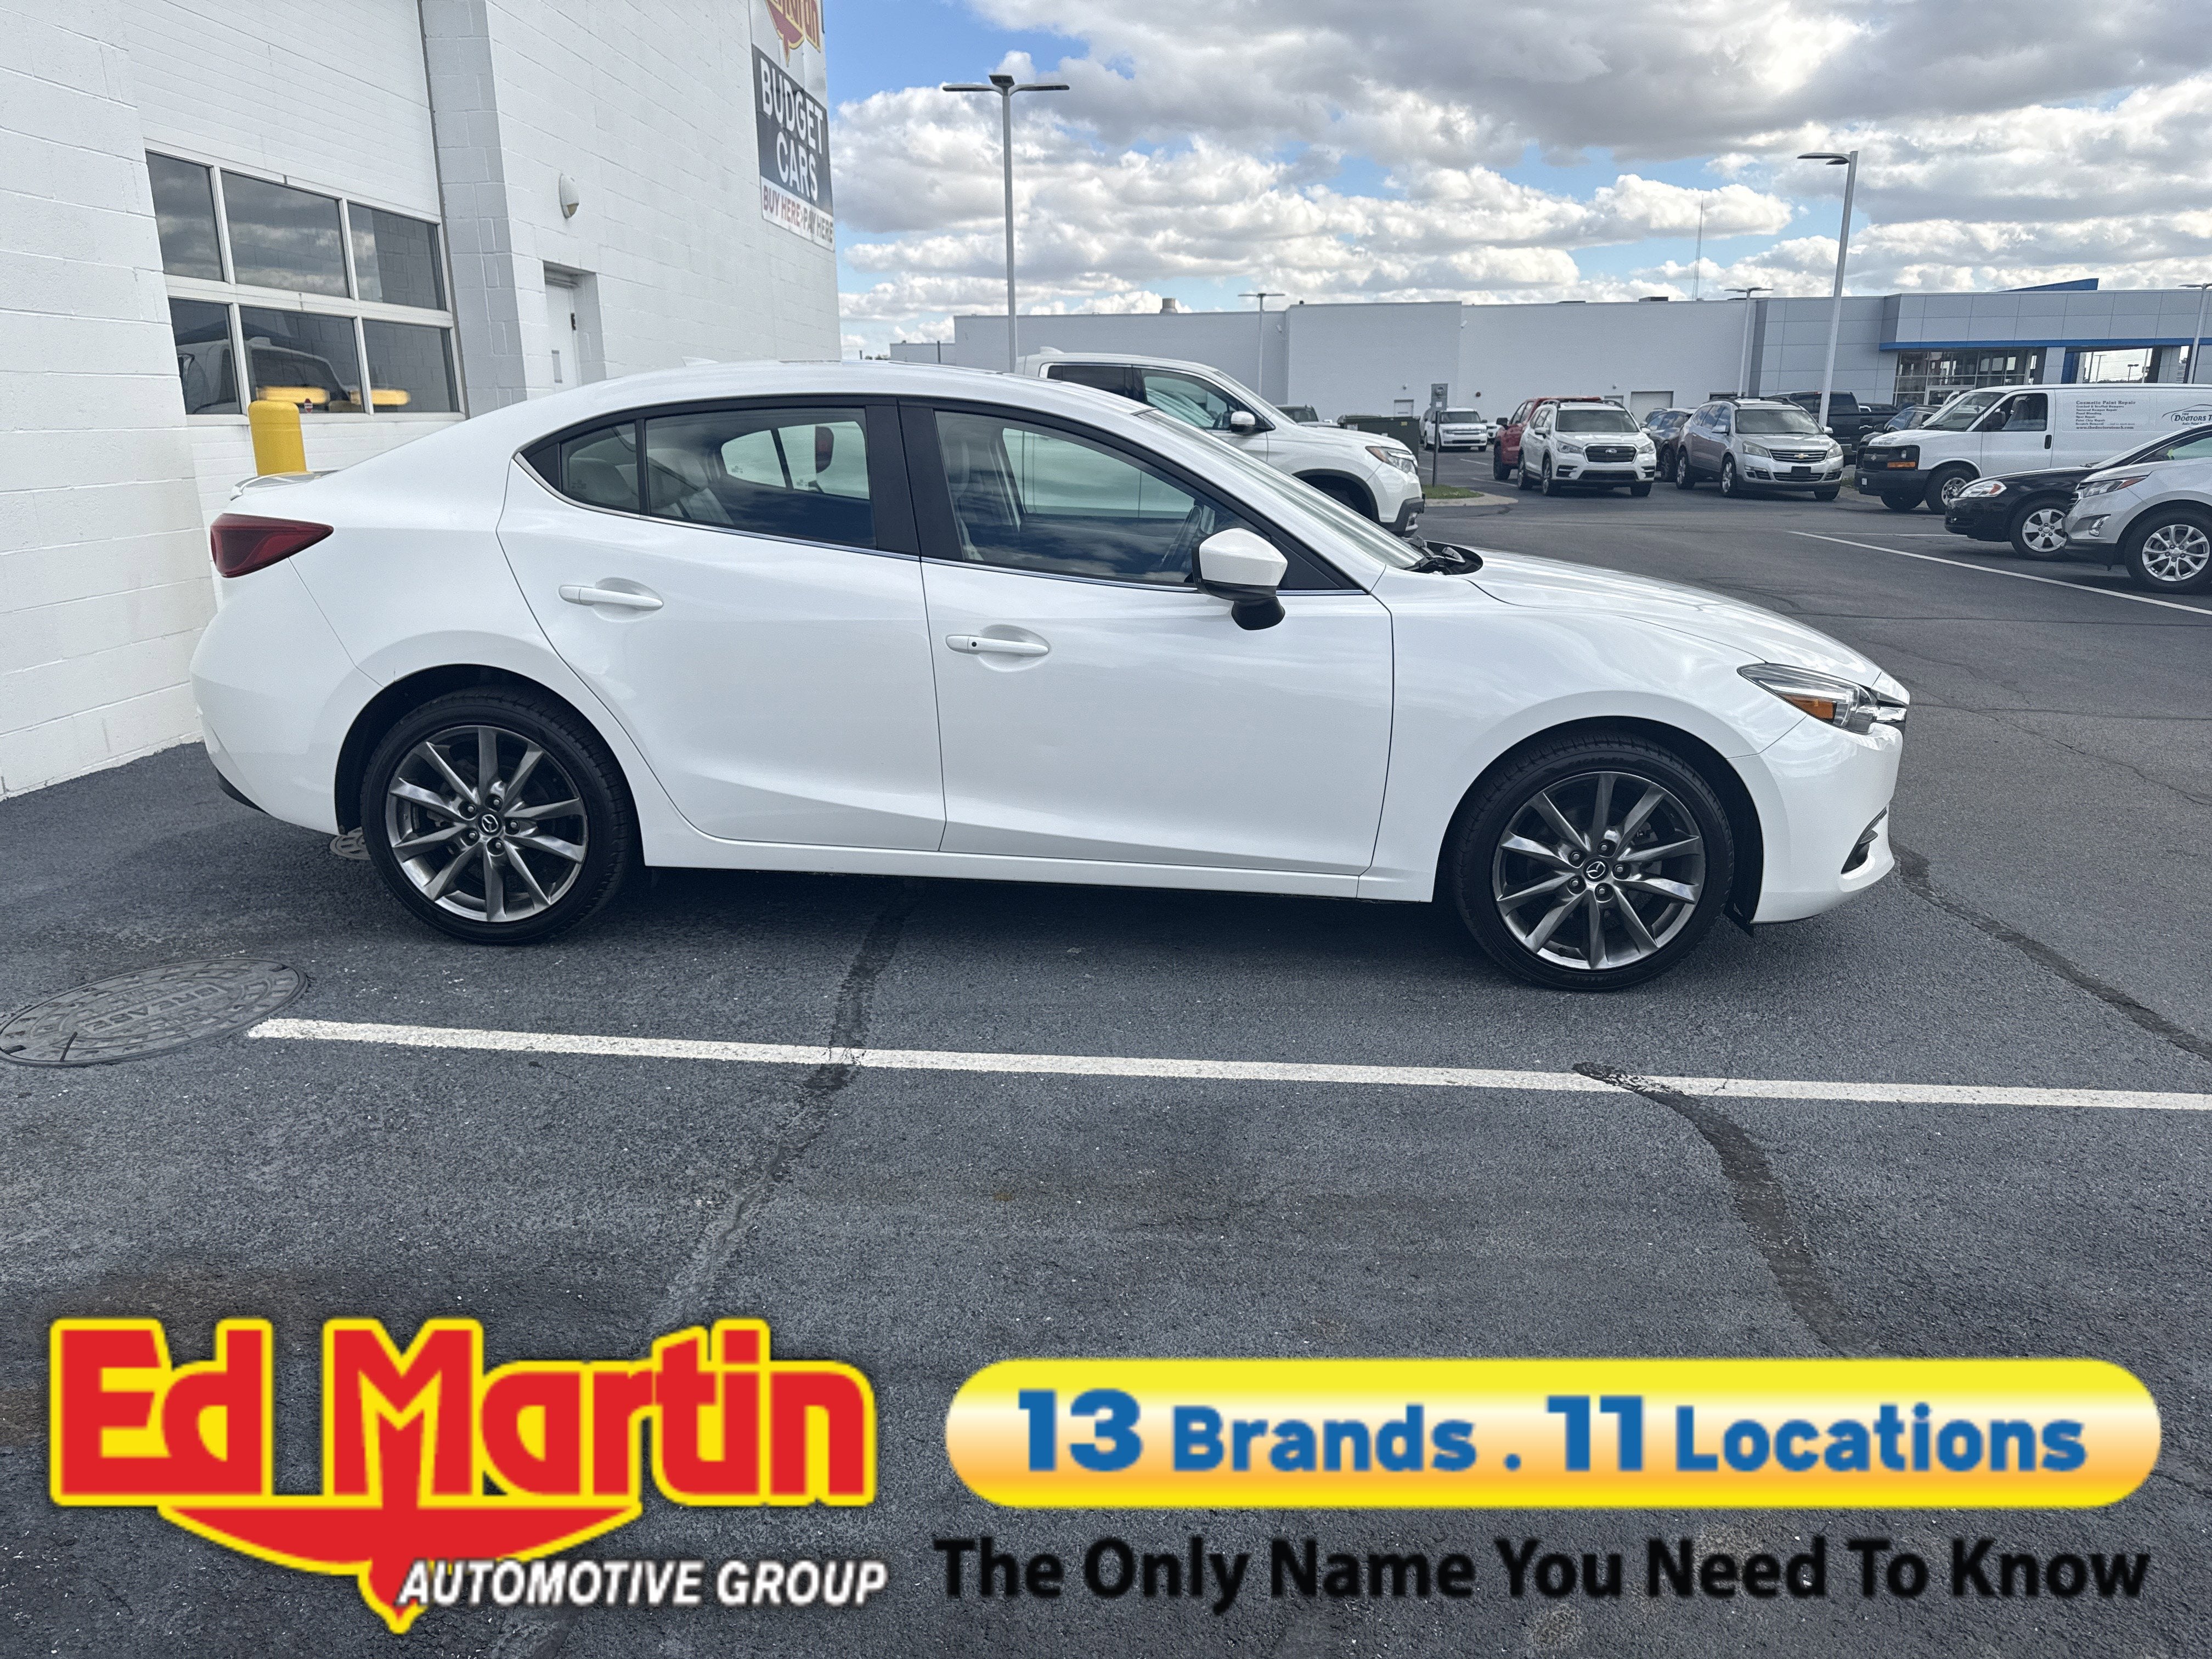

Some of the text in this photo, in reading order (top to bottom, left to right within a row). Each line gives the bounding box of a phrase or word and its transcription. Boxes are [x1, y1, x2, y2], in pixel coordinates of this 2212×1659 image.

[760, 57, 823, 155] BUDGET
[776, 131, 818, 201] CARS
[763, 185, 833, 243] BUY HERE PAY HERE
